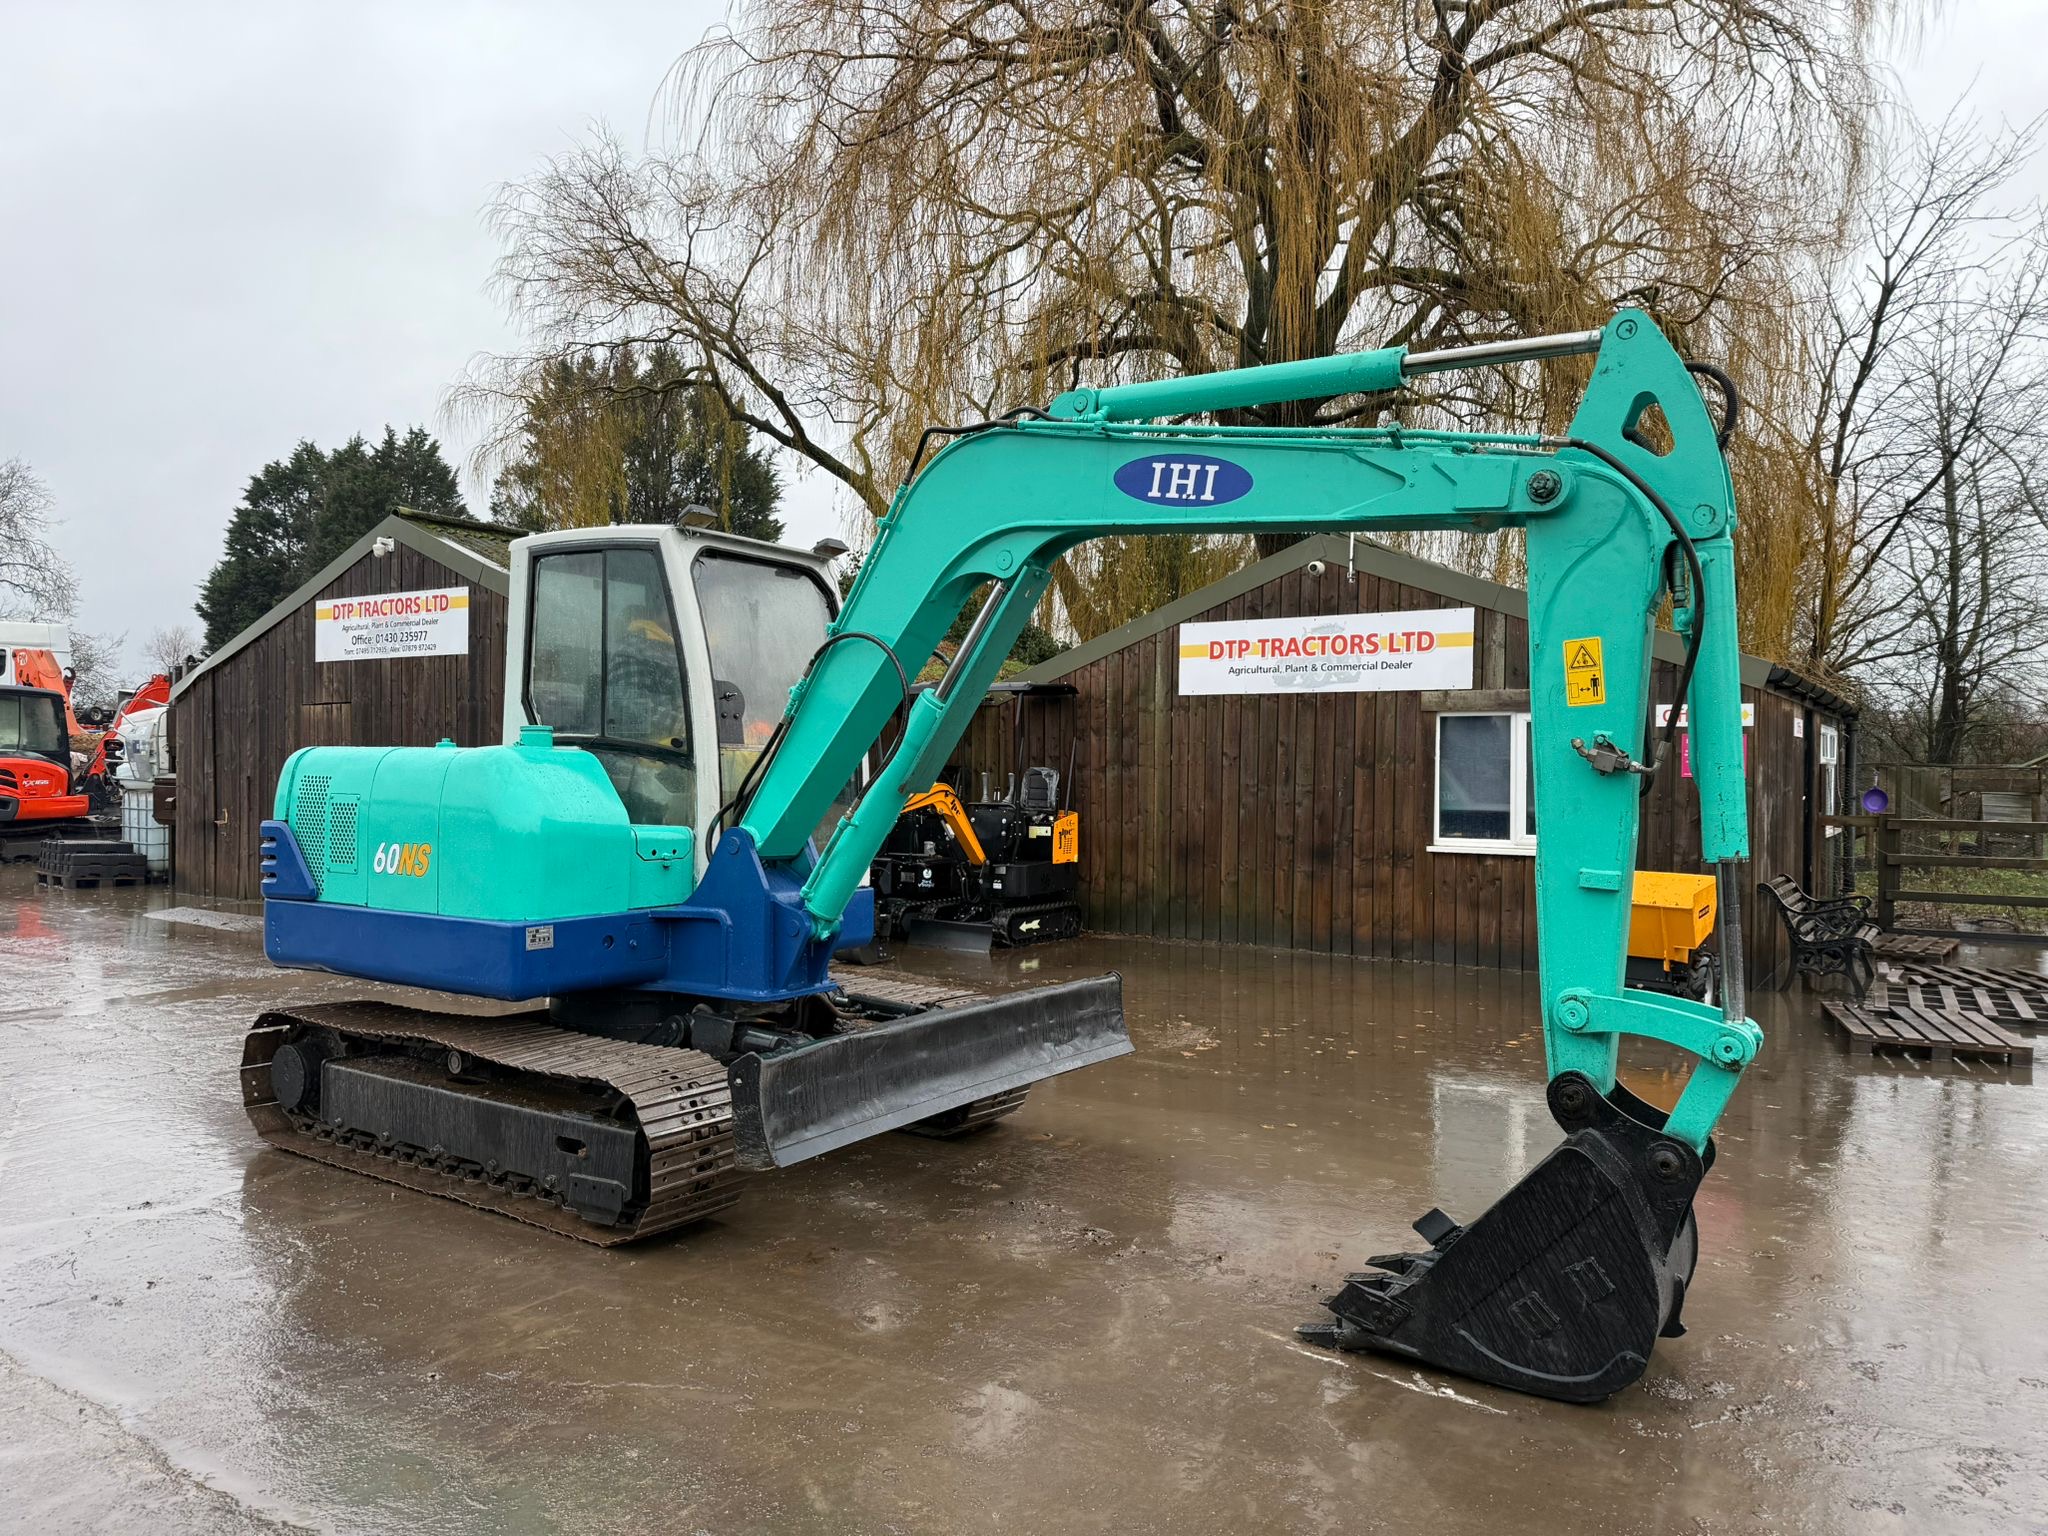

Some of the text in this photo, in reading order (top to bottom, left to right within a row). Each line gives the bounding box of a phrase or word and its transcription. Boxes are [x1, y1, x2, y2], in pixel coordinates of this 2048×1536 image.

[1147, 462, 1220, 501] IHI
[332, 594, 449, 620] DTP TRACTORS LTD
[371, 621, 384, 629] Plant
[385, 620, 389, 628] &
[390, 618, 421, 628] Commercial
[421, 617, 439, 626] Dealer
[351, 630, 428, 646] Office: 01430 235977
[1208, 630, 1436, 660] DTP TRACTORS LTD
[1228, 660, 1413, 676] Agricultural, Plant & Commercial Dealer
[373, 842, 432, 878] 60NS
